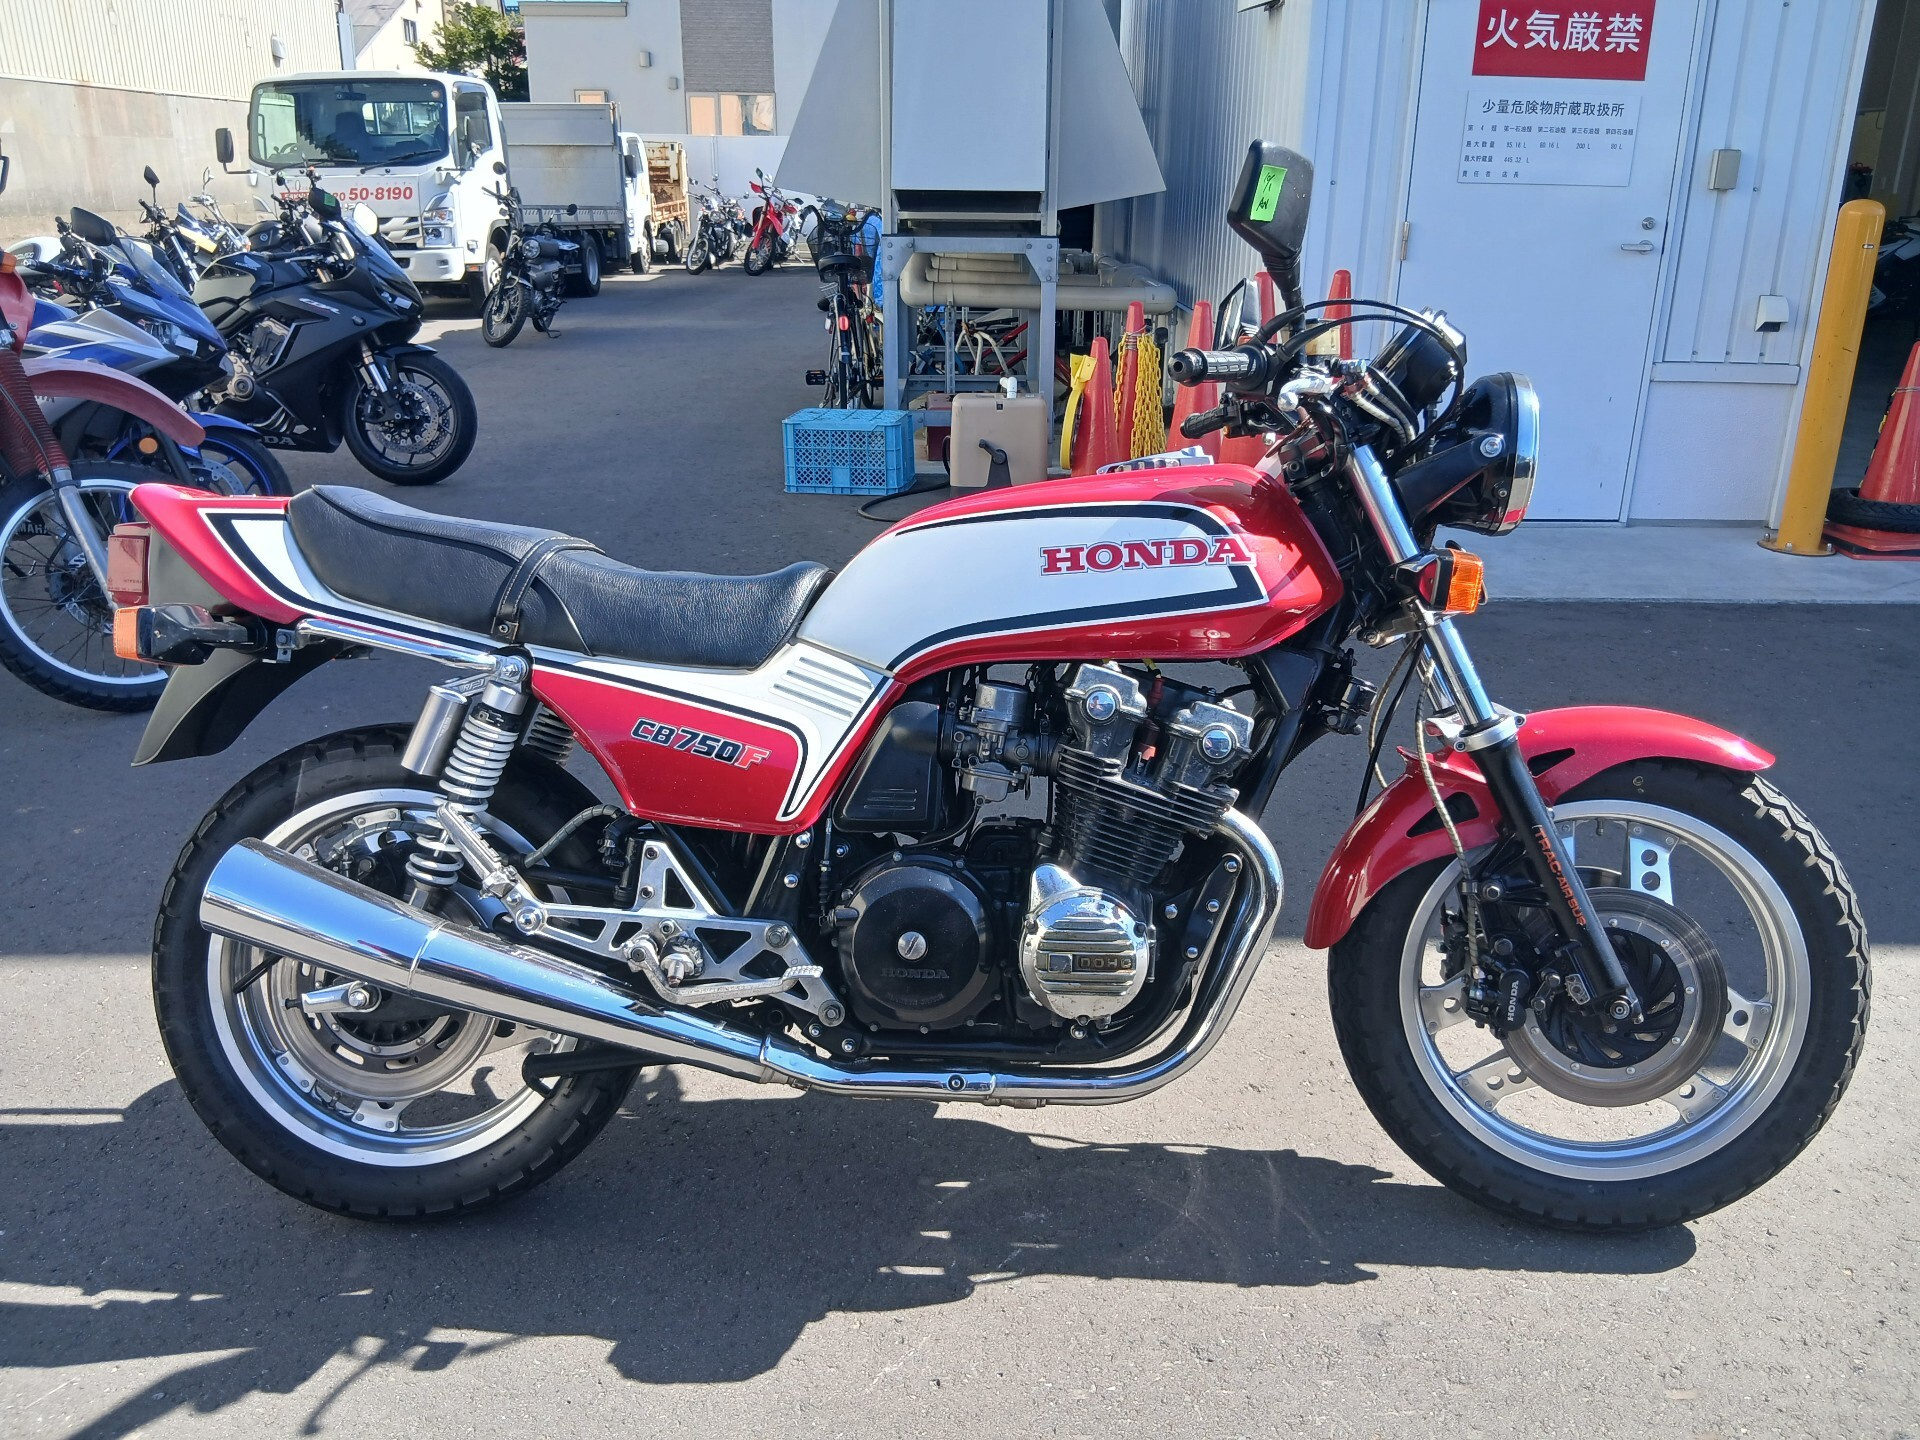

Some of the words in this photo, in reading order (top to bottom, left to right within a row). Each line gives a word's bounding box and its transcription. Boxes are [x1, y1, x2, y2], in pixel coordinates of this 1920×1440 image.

[1482, 9, 1643, 53] 火気厳禁
[1482, 99, 1625, 117] 少量危険物貯蔵取扱所
[1041, 536, 1252, 575] HONDA
[631, 717, 772, 770] CB750F
[880, 967, 950, 979] HONDA
[1079, 957, 1132, 969] DOHC
[1507, 980, 1520, 1022] HONDA
